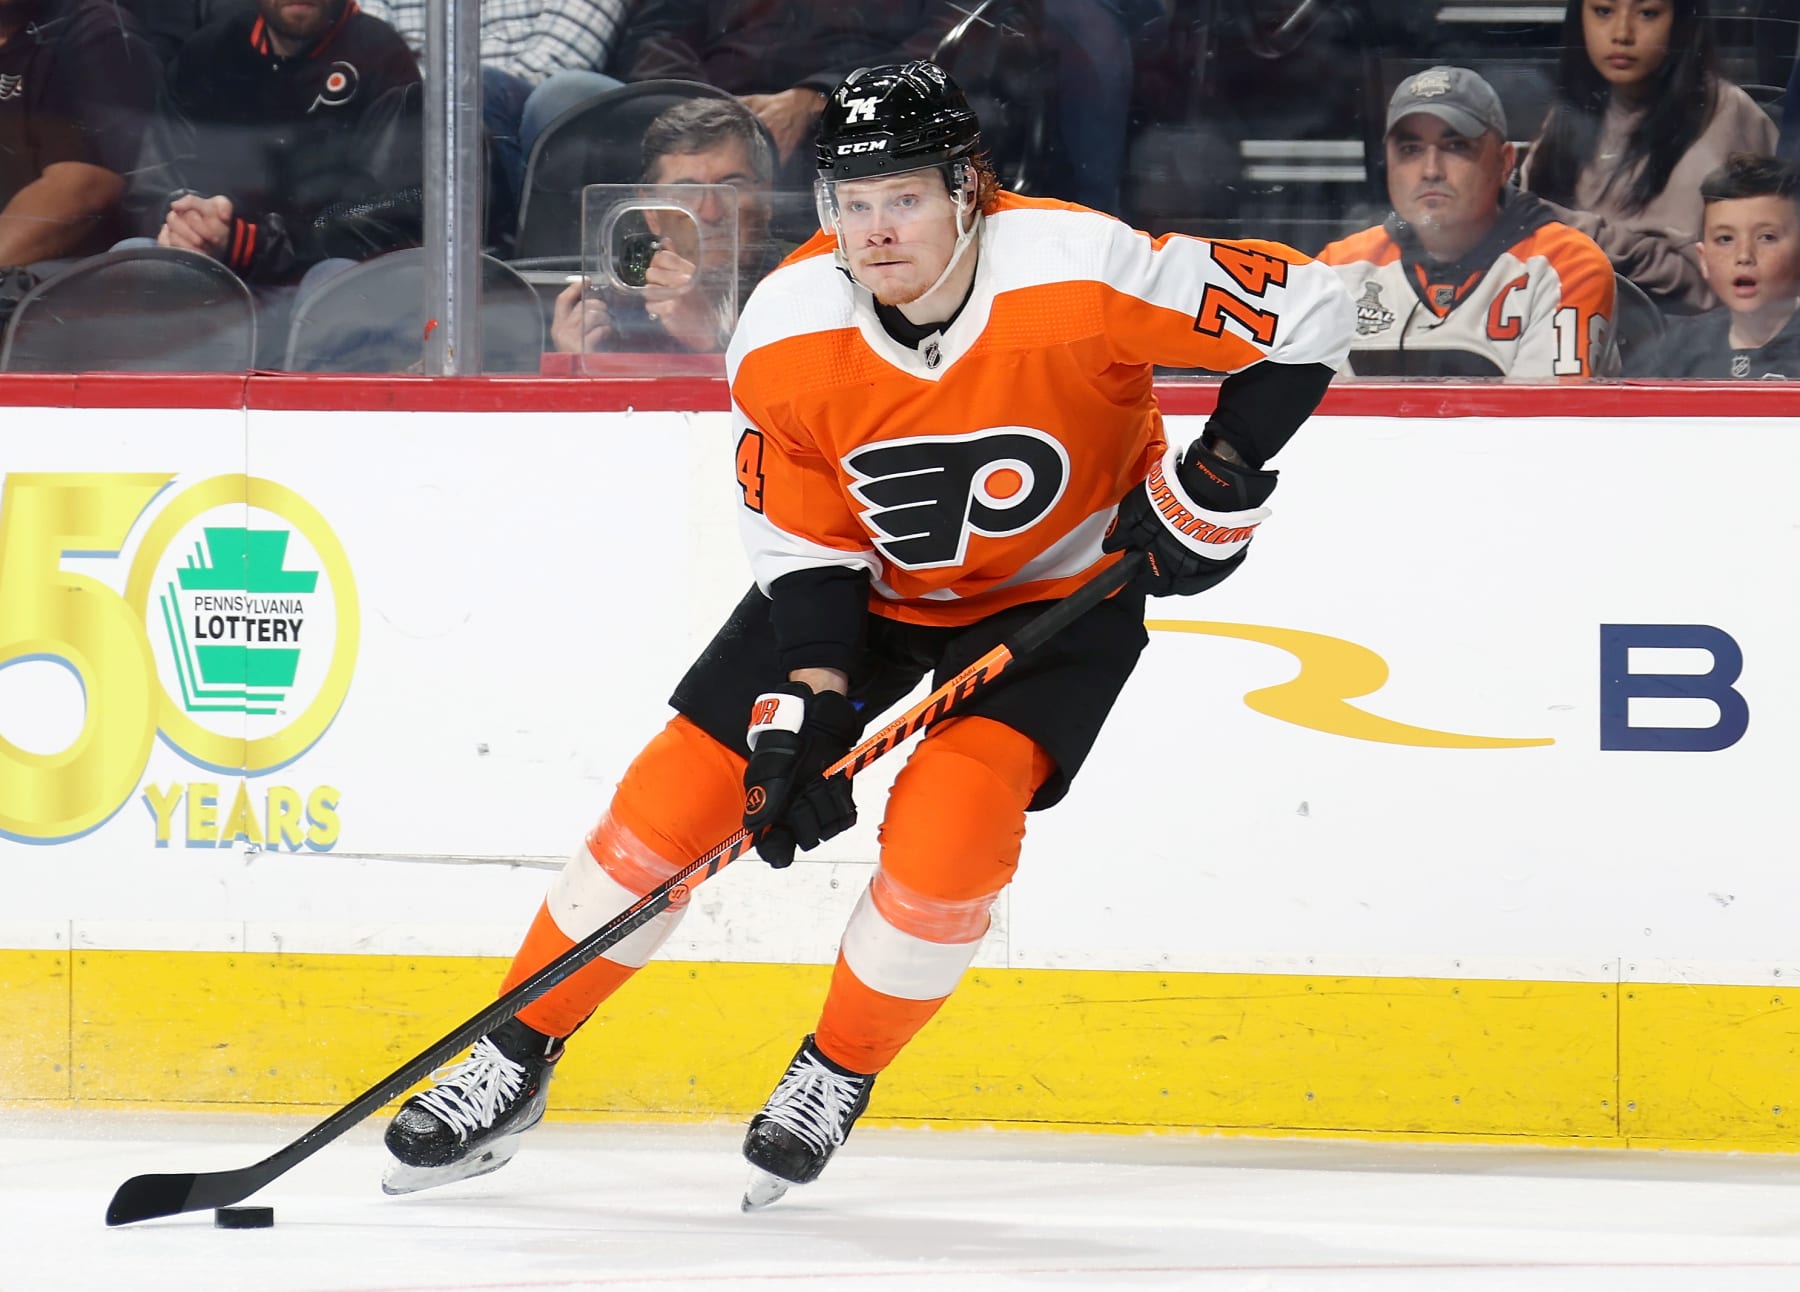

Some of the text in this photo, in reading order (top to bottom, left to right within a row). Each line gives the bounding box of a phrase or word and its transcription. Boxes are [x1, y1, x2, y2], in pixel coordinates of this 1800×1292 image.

[846, 96, 877, 124] 74
[837, 139, 888, 156] CCM
[1193, 241, 1288, 347] 74
[1486, 273, 1530, 341] C
[194, 596, 304, 614] PENNSYLVANIA
[195, 615, 304, 642] LOTTERY
[1600, 623, 1750, 752] B
[141, 778, 343, 852] YEARS
[581, 903, 659, 964] COVERT
